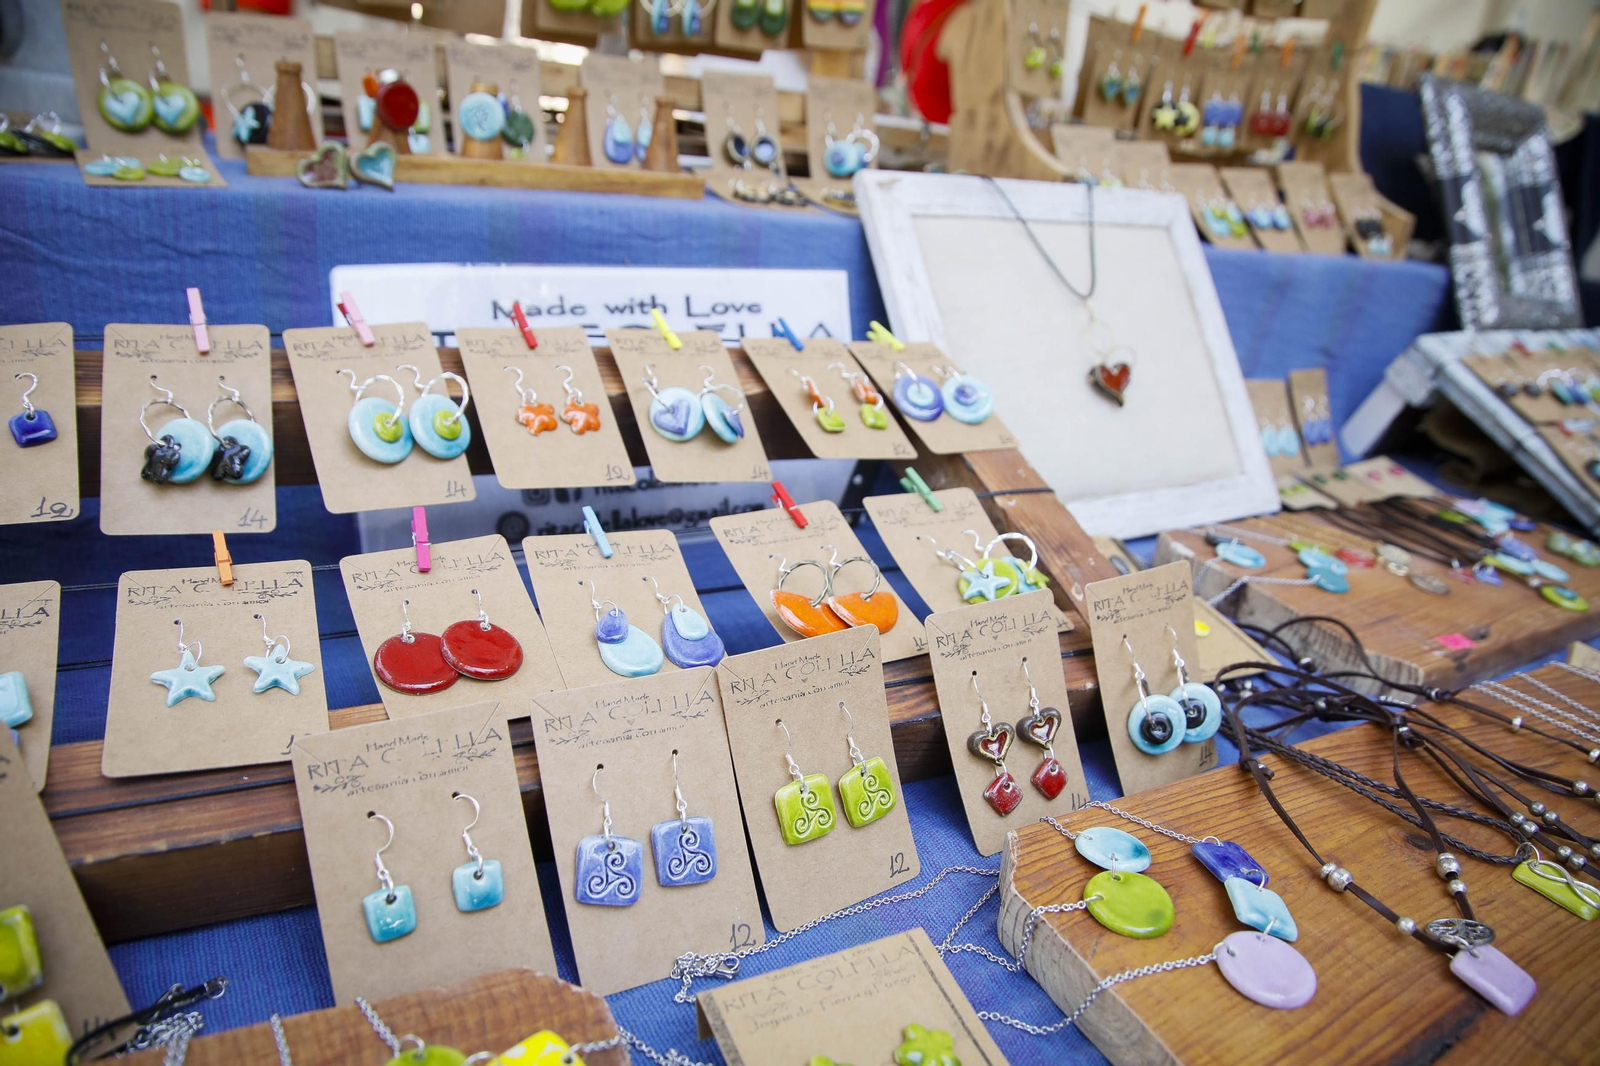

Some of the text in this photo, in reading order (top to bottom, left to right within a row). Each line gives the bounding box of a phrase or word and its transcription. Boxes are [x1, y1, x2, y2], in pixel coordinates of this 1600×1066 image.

[492, 295, 762, 321] Made with Love
[606, 463, 631, 481] 12
[751, 463, 769, 481] 14
[445, 478, 467, 498] 14
[237, 507, 268, 530] 14
[534, 548, 580, 560] RITA
[351, 568, 401, 584] RITA
[127, 584, 182, 597] RITA
[1093, 595, 1125, 612] RITA
[935, 629, 973, 648] RITA
[730, 673, 777, 695] RITA
[544, 712, 598, 733] RITA
[1197, 745, 1213, 768] 14
[307, 755, 369, 780] RITA
[889, 852, 911, 879] 12
[729, 923, 757, 951] 12
[724, 985, 787, 1014] RITA
